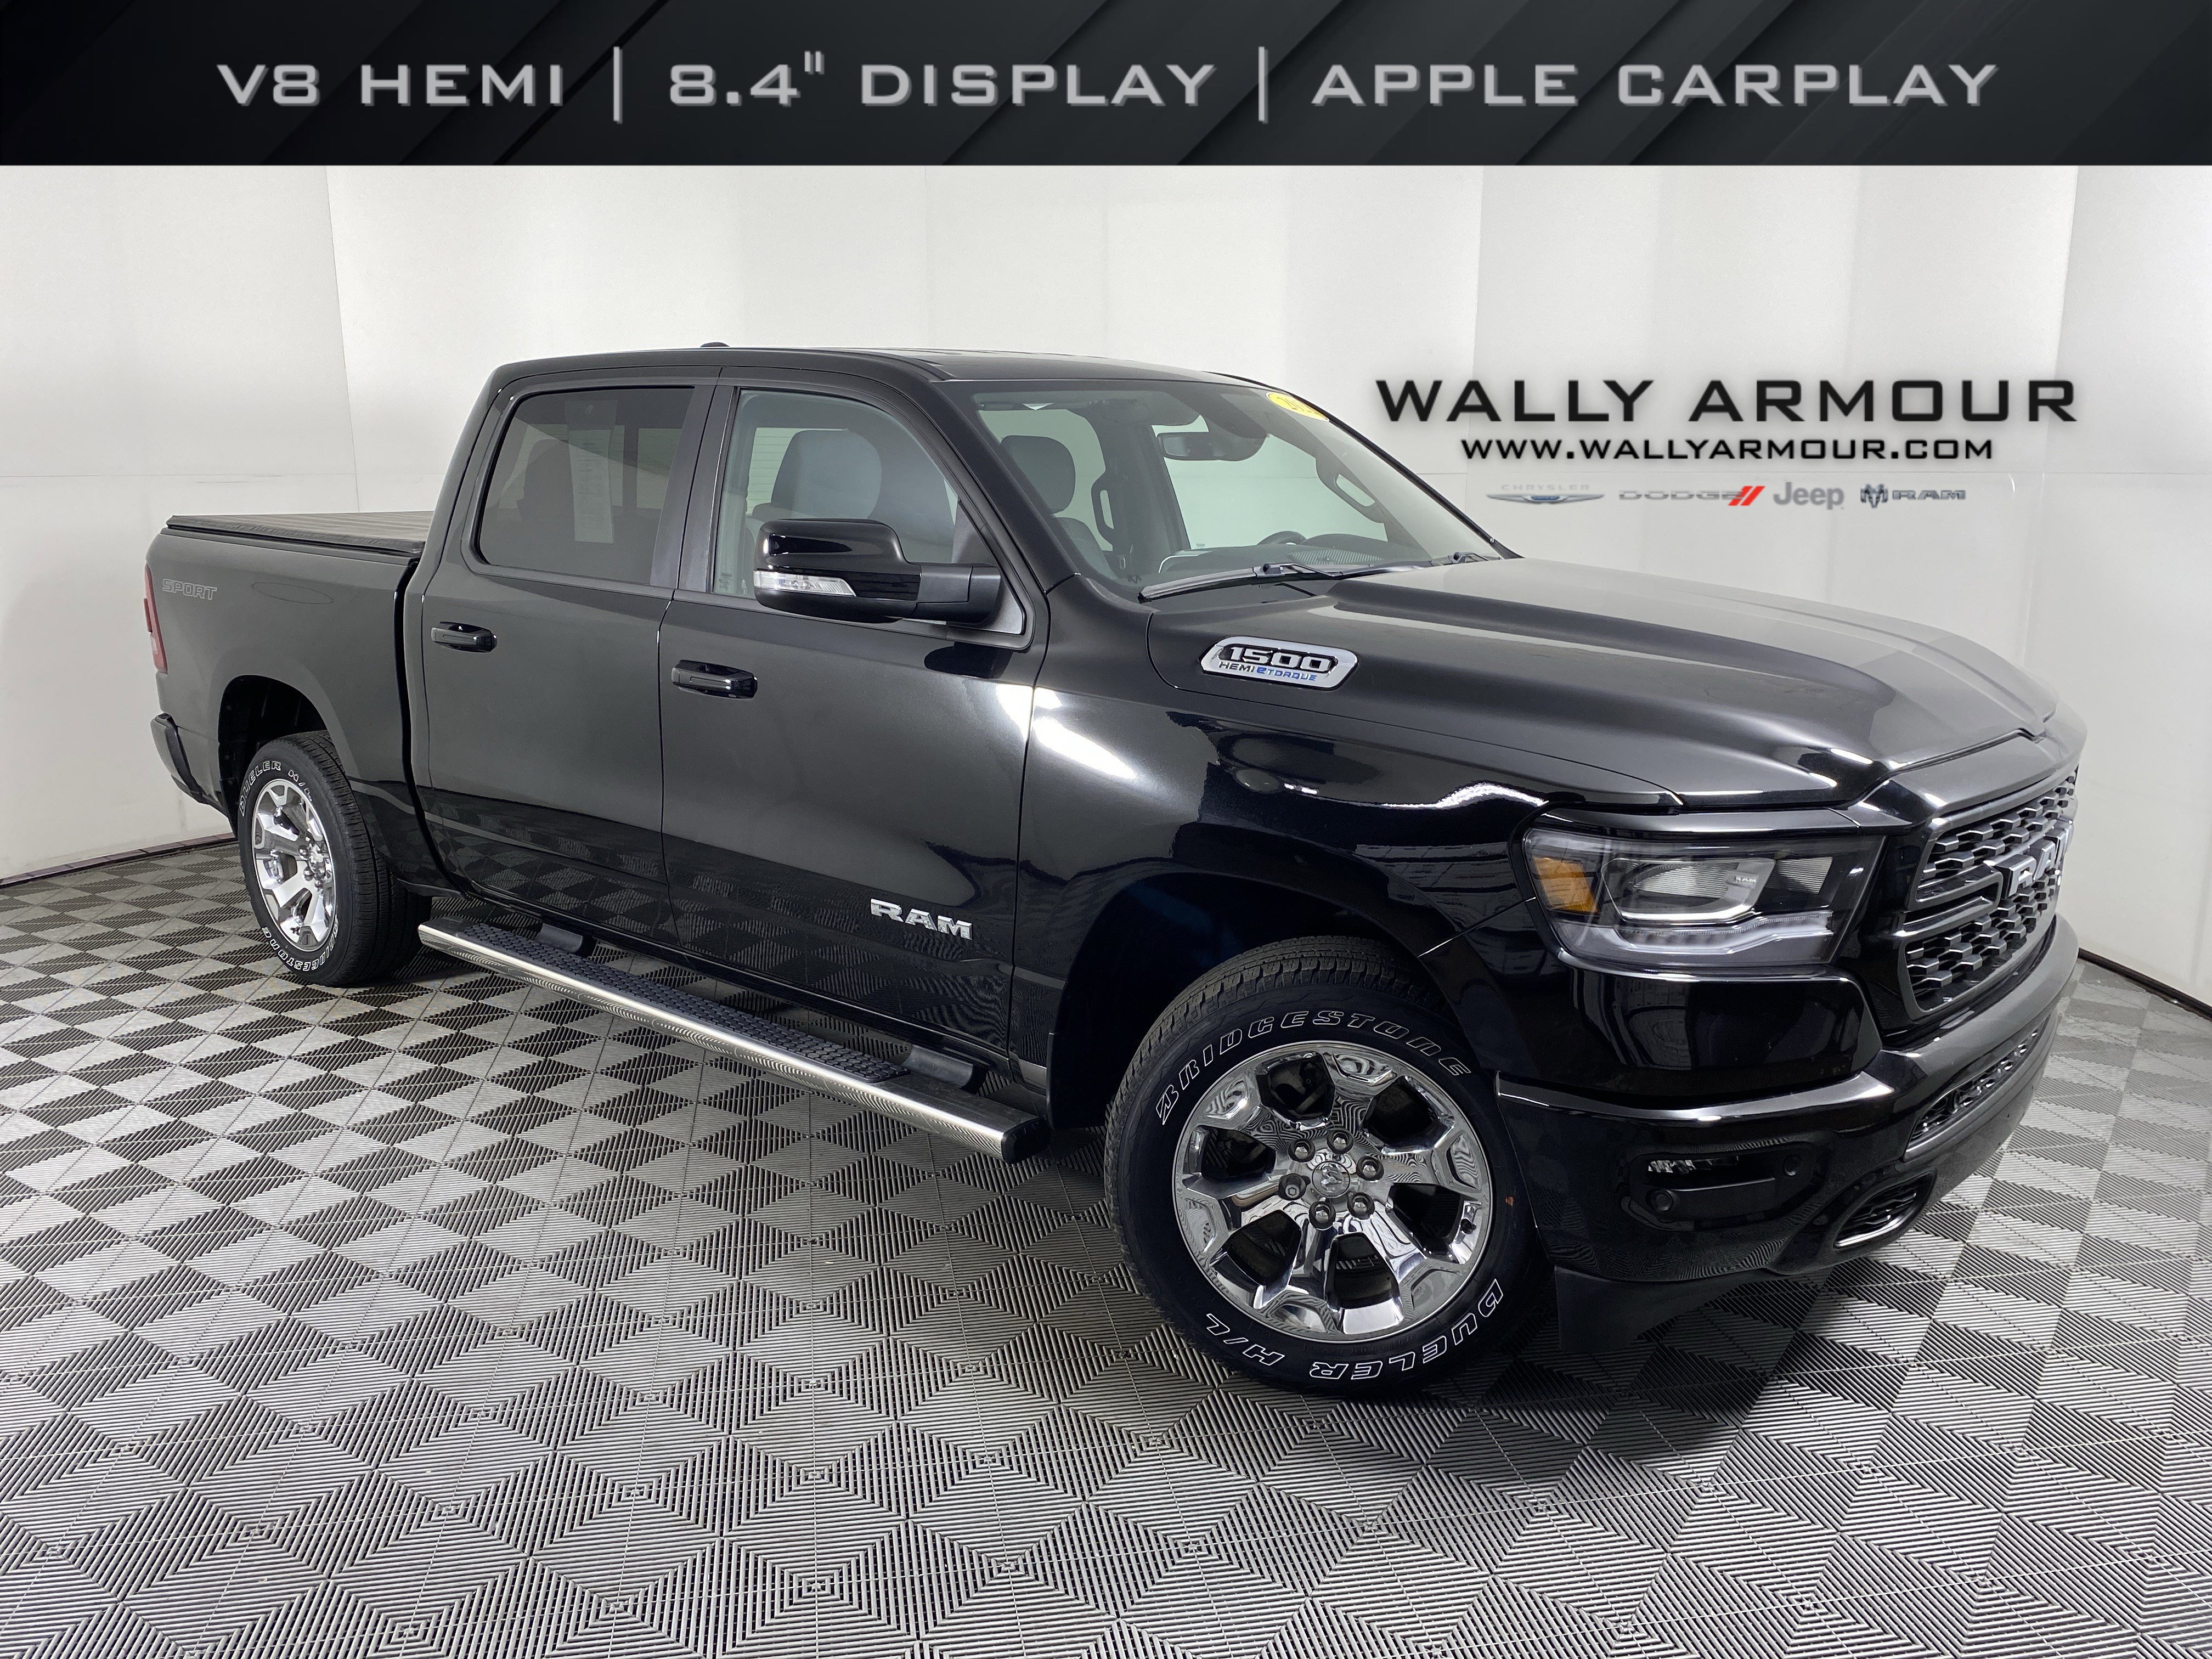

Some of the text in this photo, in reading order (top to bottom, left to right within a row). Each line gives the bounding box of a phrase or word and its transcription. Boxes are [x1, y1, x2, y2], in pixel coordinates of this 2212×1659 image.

[162, 578, 217, 601] SPORT
[1218, 661, 1255, 673] HEMI
[1230, 646, 1332, 672] 1500
[239, 760, 281, 817] DUELER
[870, 898, 973, 940] RAM
[1155, 1009, 1472, 1126] BRIDGESTONE
[1206, 1278, 1504, 1381] DUELER H/L
